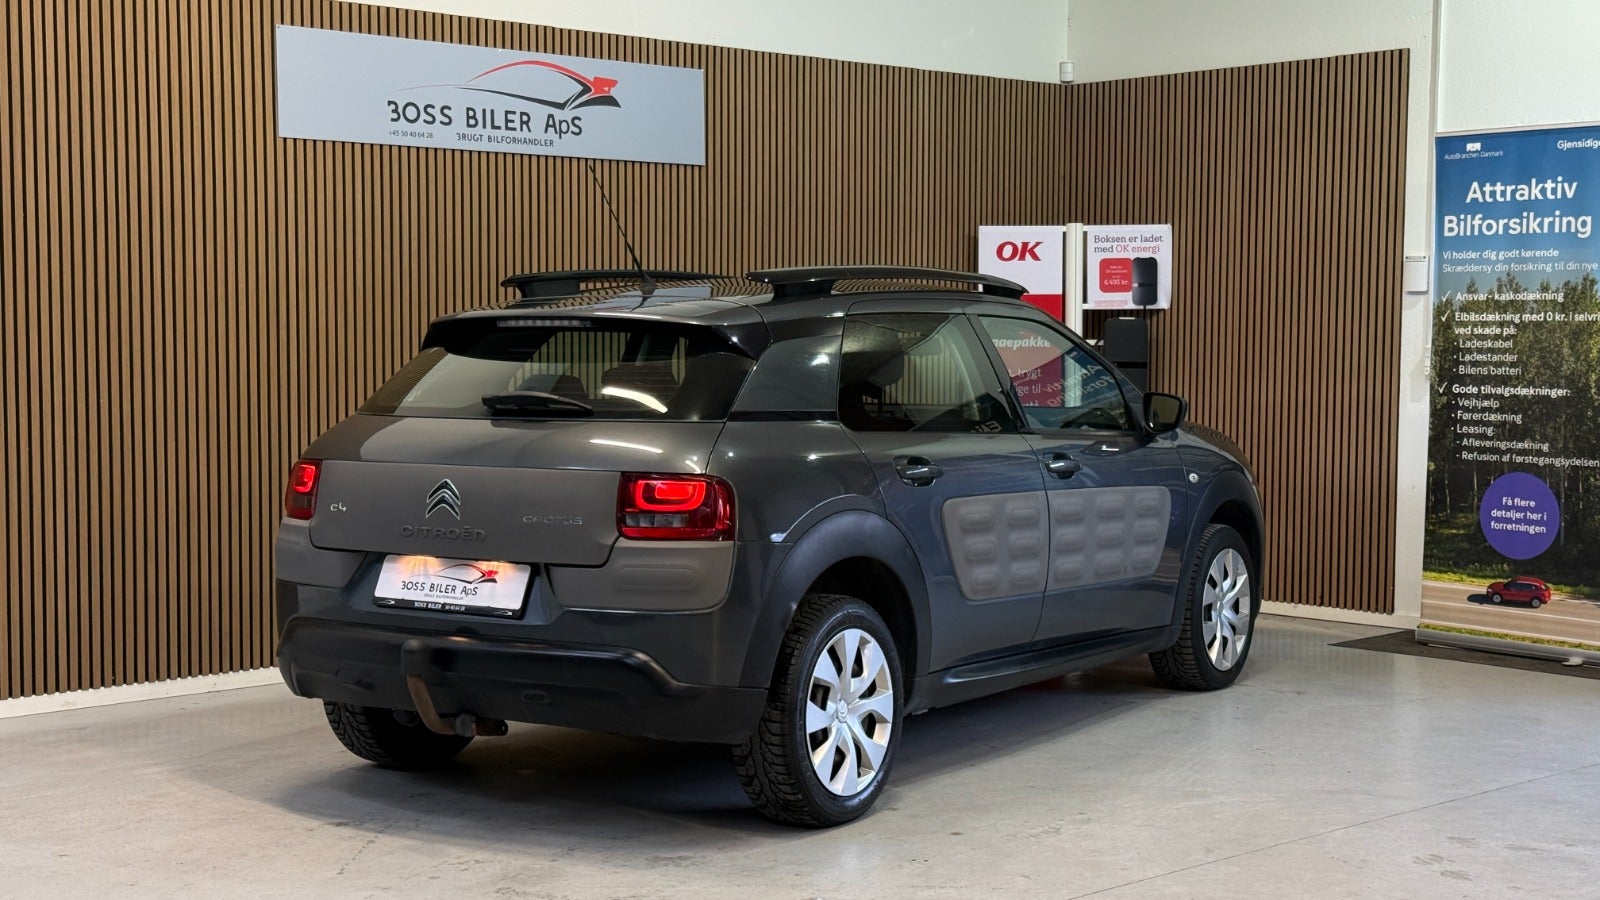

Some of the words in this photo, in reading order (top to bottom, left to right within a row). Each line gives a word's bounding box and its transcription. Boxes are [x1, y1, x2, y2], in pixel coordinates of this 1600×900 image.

[465, 106, 532, 133] BILER
[544, 113, 583, 140] ApS
[389, 129, 399, 137] +45
[409, 130, 417, 138] 40
[487, 134, 554, 147] BILFORHANDLER
[1480, 150, 1504, 158] Danmark
[1465, 175, 1578, 204] Attraktiv
[1443, 210, 1592, 239] Bilforsikring
[1094, 235, 1126, 243] Boksen
[1140, 234, 1164, 243] ladet
[995, 241, 1044, 262] OK
[1094, 244, 1114, 253] med
[1115, 244, 1130, 253] OK
[1131, 244, 1160, 254] energi
[1442, 250, 1451, 259] Vi
[1452, 249, 1481, 259] holder
[1482, 249, 1497, 261] dig
[1498, 249, 1520, 261] godt
[1521, 247, 1559, 258] kørende
[1442, 263, 1493, 274] Skræddersy
[1494, 262, 1509, 272] din
[1510, 261, 1553, 273] forsikring
[1554, 261, 1565, 271] til
[1566, 260, 1580, 271] din
[1581, 261, 1599, 272] nye
[1455, 291, 1493, 301] Ansvar-
[1494, 290, 1564, 303] kaskodækning
[1455, 311, 1521, 324] Elbilsdækning
[1522, 311, 1544, 321] med
[1546, 311, 1553, 321] 0
[1555, 311, 1567, 321] kr.
[1454, 325, 1471, 335] ved
[1473, 325, 1501, 335] skade
[1503, 325, 1517, 337] på:
[1459, 339, 1513, 348] Ladeskabel
[1459, 352, 1518, 362] Ladestander
[1458, 365, 1488, 375] Bilens
[1490, 365, 1522, 376] batteri
[1032, 383, 1041, 394] til
[1452, 384, 1478, 394] Gode
[1480, 385, 1571, 399] tilvalgsdækninger:
[1457, 397, 1500, 409] Vejhjælp
[1457, 411, 1523, 424] Førerdækning
[1456, 423, 1496, 437] Leasing:
[1461, 438, 1549, 452] Afleveringsdækning
[1461, 451, 1500, 462] Refusion
[1501, 453, 1511, 462] af
[1502, 496, 1512, 506] Få
[1514, 497, 1535, 508] flere
[1491, 509, 1525, 521] detaljer
[1526, 510, 1542, 520] her
[1491, 521, 1546, 535] forretningen
[429, 583, 457, 594] BILER
[460, 585, 479, 598] ApS
